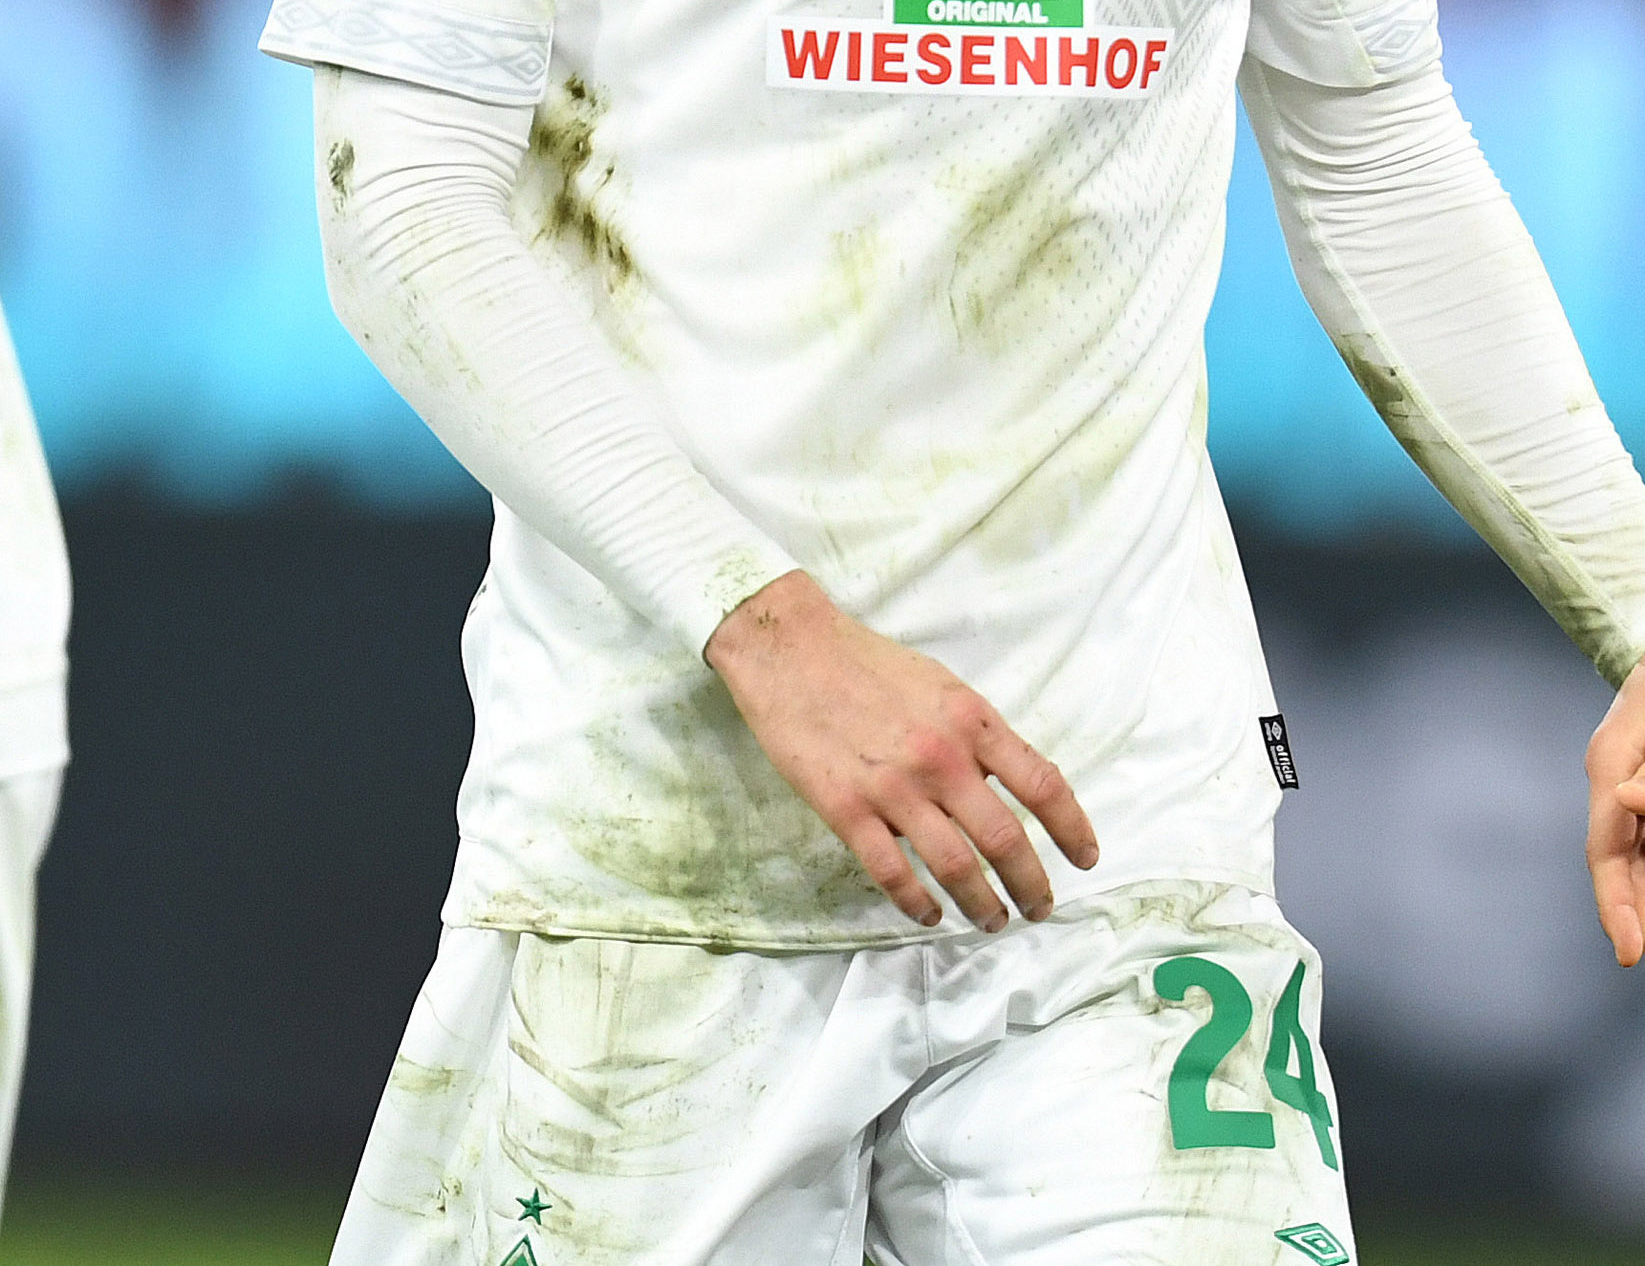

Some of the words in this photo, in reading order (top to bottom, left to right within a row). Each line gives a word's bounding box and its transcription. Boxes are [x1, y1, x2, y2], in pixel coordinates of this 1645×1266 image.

[927, 0, 1048, 24] ORIGINAL
[781, 29, 1167, 89] WIESENHOF
[1276, 744, 1296, 783] official
[1153, 956, 1338, 1172] 24
